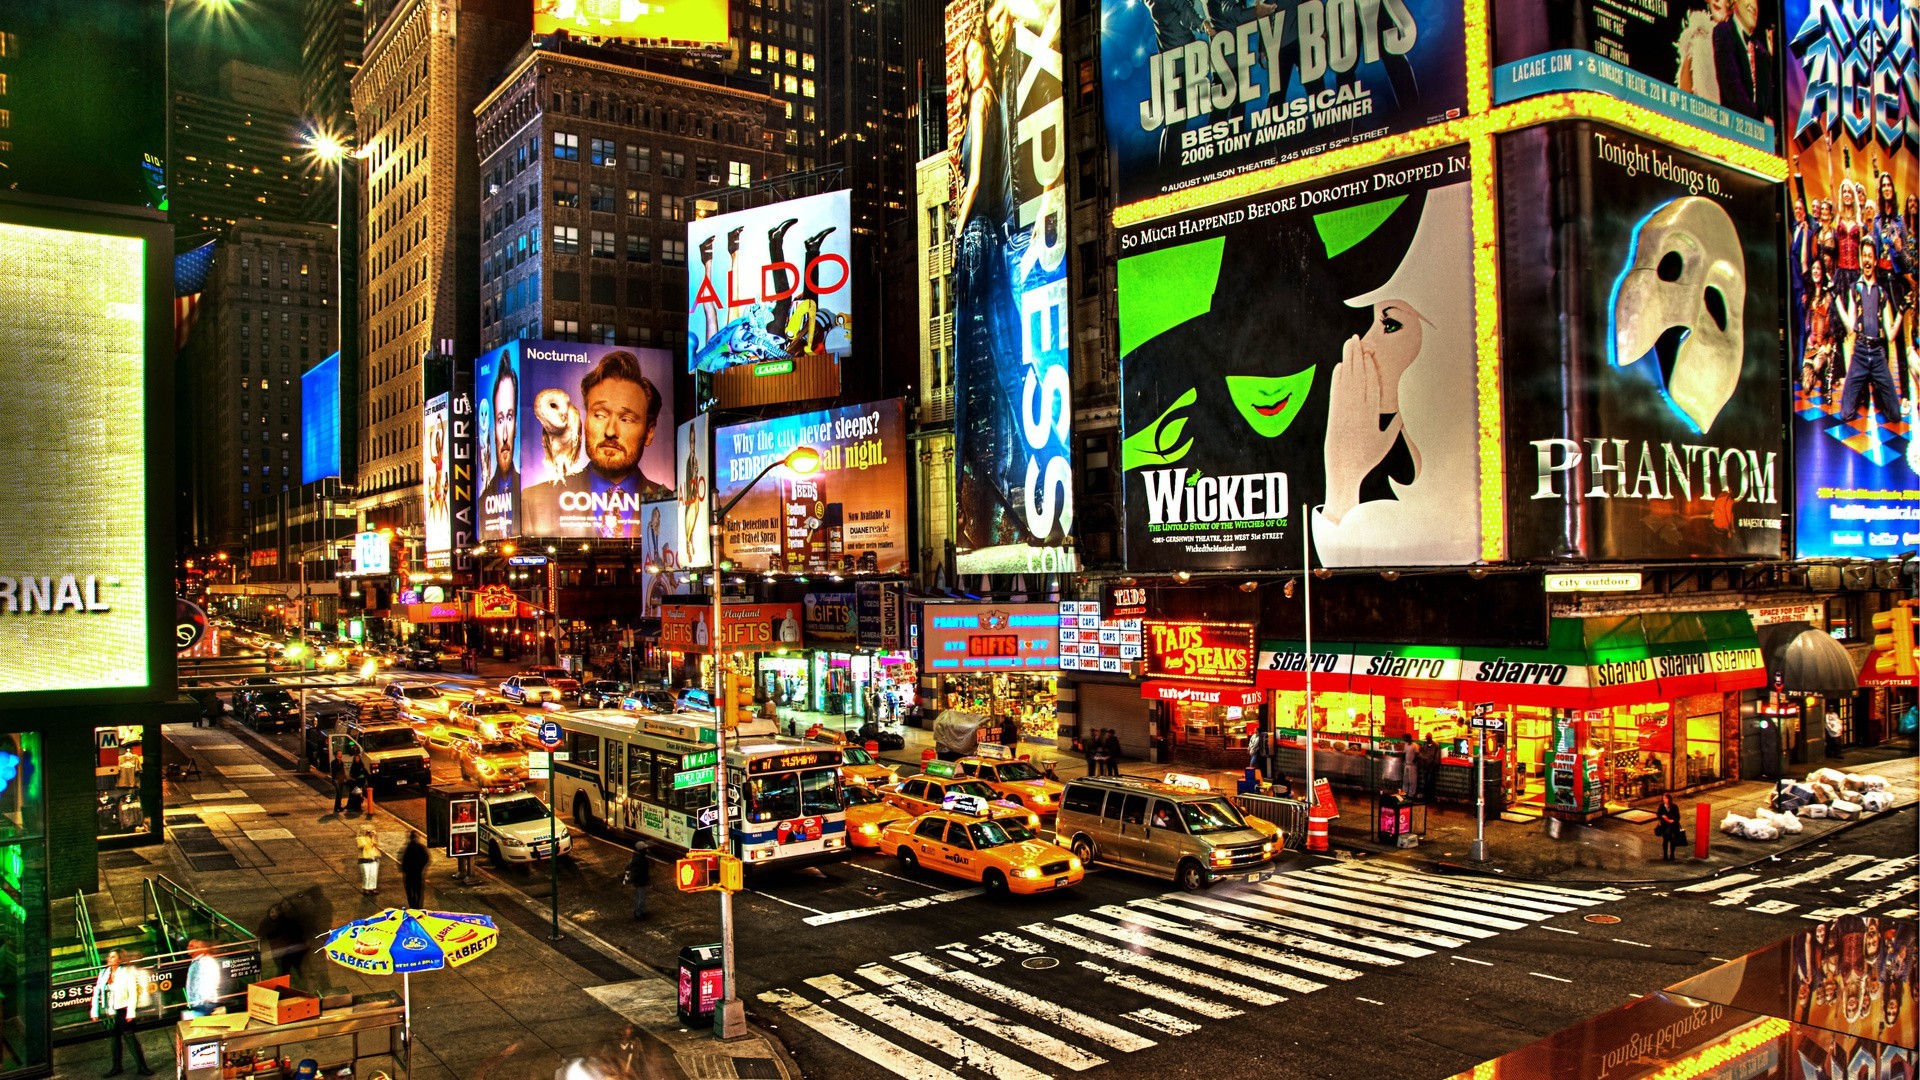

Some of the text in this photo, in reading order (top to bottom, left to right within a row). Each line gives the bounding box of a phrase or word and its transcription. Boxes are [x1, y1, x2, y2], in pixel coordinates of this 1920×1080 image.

[1140, 0, 1418, 131] JERSEY BOYS
[1512, 54, 1572, 83] LACAGE.COM
[1181, 81, 1371, 148] BEST MUSICAL
[1181, 99, 1373, 166] 2006 TONY AWARD WINNER
[1168, 177, 1201, 191] AUGUST
[1203, 169, 1236, 183] WILSON
[1237, 157, 1279, 174] THEATRE,
[1281, 153, 1299, 163] 245
[1301, 144, 1327, 158] WEST
[1353, 127, 1390, 142] STREET
[1594, 132, 1650, 177] Tonight
[1652, 149, 1704, 195] belongs
[688, 253, 850, 313] ALDO
[527, 348, 591, 364] Nocturnal.
[758, 362, 789, 374] LAMAR
[733, 433, 754, 455] Why
[757, 430, 775, 451] the
[801, 421, 832, 446] never
[835, 411, 880, 440] sleeps?
[823, 438, 888, 471] all night.
[1529, 437, 1778, 504] PHANTOM
[559, 491, 640, 511] CONAN
[678, 476, 706, 507] ALDO
[485, 492, 512, 514] CONAN
[728, 517, 779, 532] Early Detection Kit
[860, 510, 884, 520] Available
[1162, 523, 1188, 531] UNTOLD
[1189, 522, 1210, 531] STORY
[1220, 522, 1233, 531] THE
[1234, 520, 1265, 530] WITCHES
[1266, 519, 1276, 528] OF
[730, 531, 777, 544] and Travel Spray
[1222, 534, 1233, 542] 222
[1262, 532, 1284, 540] STREET
[1585, 577, 1630, 586] outdoor
[722, 608, 761, 620] Playland
[813, 604, 850, 624] GIFTS
[1063, 604, 1098, 612] CAPS T-SHIRTS
[663, 622, 692, 643] GIFTS
[714, 622, 770, 643] GIFTS
[1082, 618, 1095, 626] CAPS
[1123, 620, 1137, 628] CAPS
[971, 636, 1018, 655] GIFTS
[1063, 631, 1075, 639] CAPS
[1103, 633, 1116, 641] CAPS
[1121, 633, 1140, 642] T-SHIRTS
[1152, 625, 1202, 654] TAD'S
[1060, 645, 1078, 653] T-SHIRTS
[1082, 645, 1095, 654] CAPS
[1124, 647, 1137, 655] CAPS
[1269, 648, 1338, 673] sbarro
[1715, 644, 1757, 671] sbarro
[1063, 658, 1075, 666] CAPS
[1080, 659, 1098, 668] T-SHIRTS
[1103, 661, 1116, 669] CAPS
[1183, 647, 1247, 675] STEAKS
[1366, 651, 1445, 678] sbarro
[1476, 655, 1568, 685] sbarro
[1660, 649, 1705, 677] sbarro
[1599, 658, 1647, 686] sbarro
[1241, 691, 1262, 705] TAD'S
[690, 752, 708, 767] W 47
[675, 769, 713, 783] FATHER DUFFY
[704, 811, 715, 820] ONE
[448, 933, 495, 962] SABRETT
[329, 949, 389, 970] SABRETT
[52, 987, 82, 1000] 49 St
